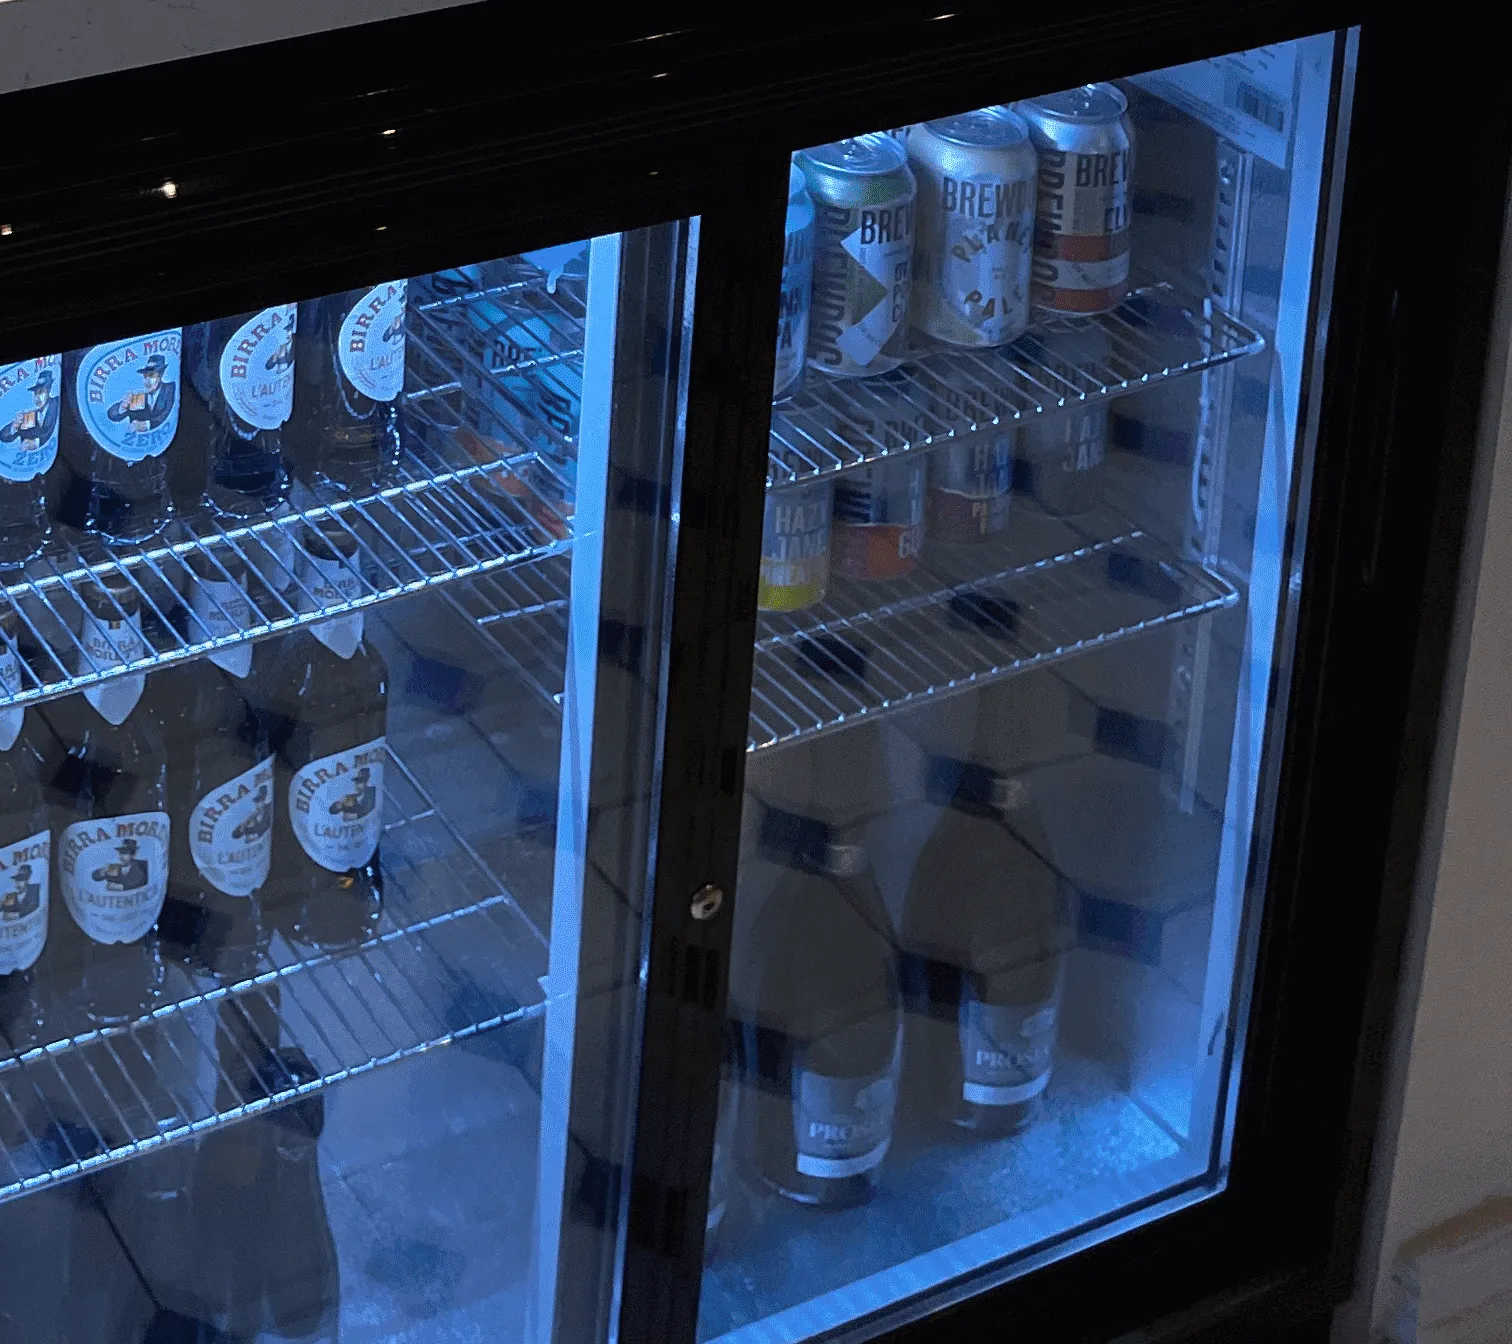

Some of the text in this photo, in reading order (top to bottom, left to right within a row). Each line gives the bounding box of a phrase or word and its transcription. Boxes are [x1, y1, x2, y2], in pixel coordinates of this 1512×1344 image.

[230, 312, 283, 380] BIRRA
[350, 284, 397, 353] BIRRA
[90, 347, 139, 406] BIRRA
[121, 421, 178, 448] ZERO
[197, 783, 250, 845] BIRRA
[296, 762, 349, 815] BIRRA
[61, 828, 111, 876] BIRRA
